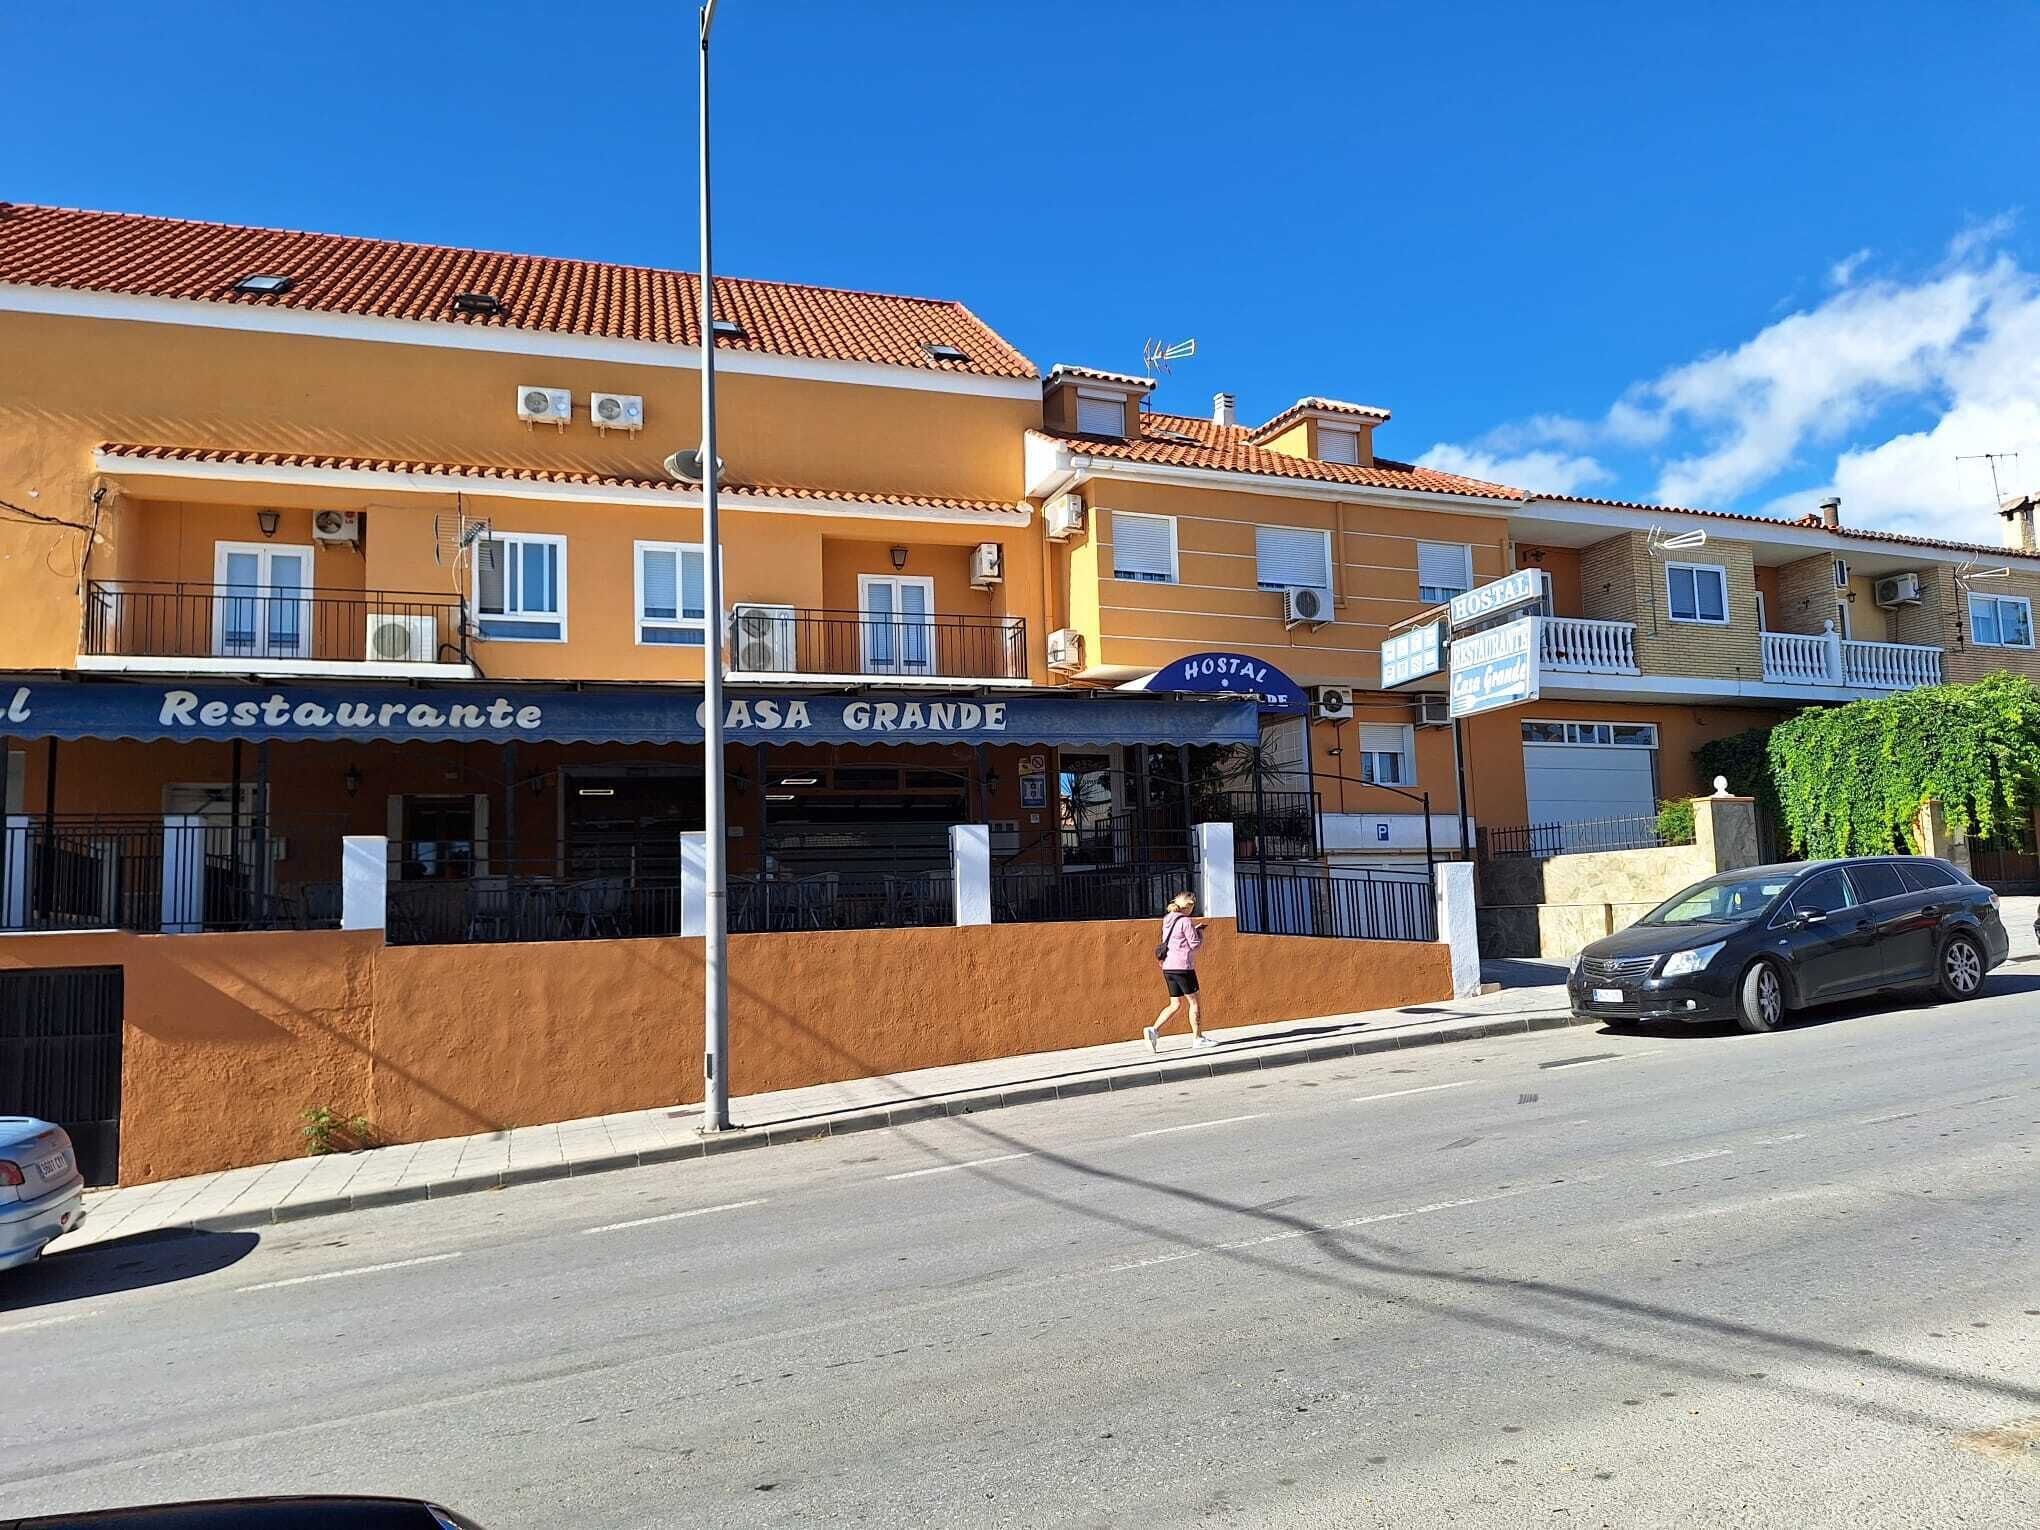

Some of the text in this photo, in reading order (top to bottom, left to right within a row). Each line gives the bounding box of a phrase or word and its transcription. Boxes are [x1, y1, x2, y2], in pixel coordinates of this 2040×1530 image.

[1454, 575, 1529, 618] HOSTAL
[1453, 627, 1529, 667] RESTAURANTE
[1185, 658, 1267, 682] HOSTAL
[1455, 659, 1527, 698] Casa Grande
[158, 689, 543, 729] Restaurante
[842, 701, 1007, 731] GRANDE
